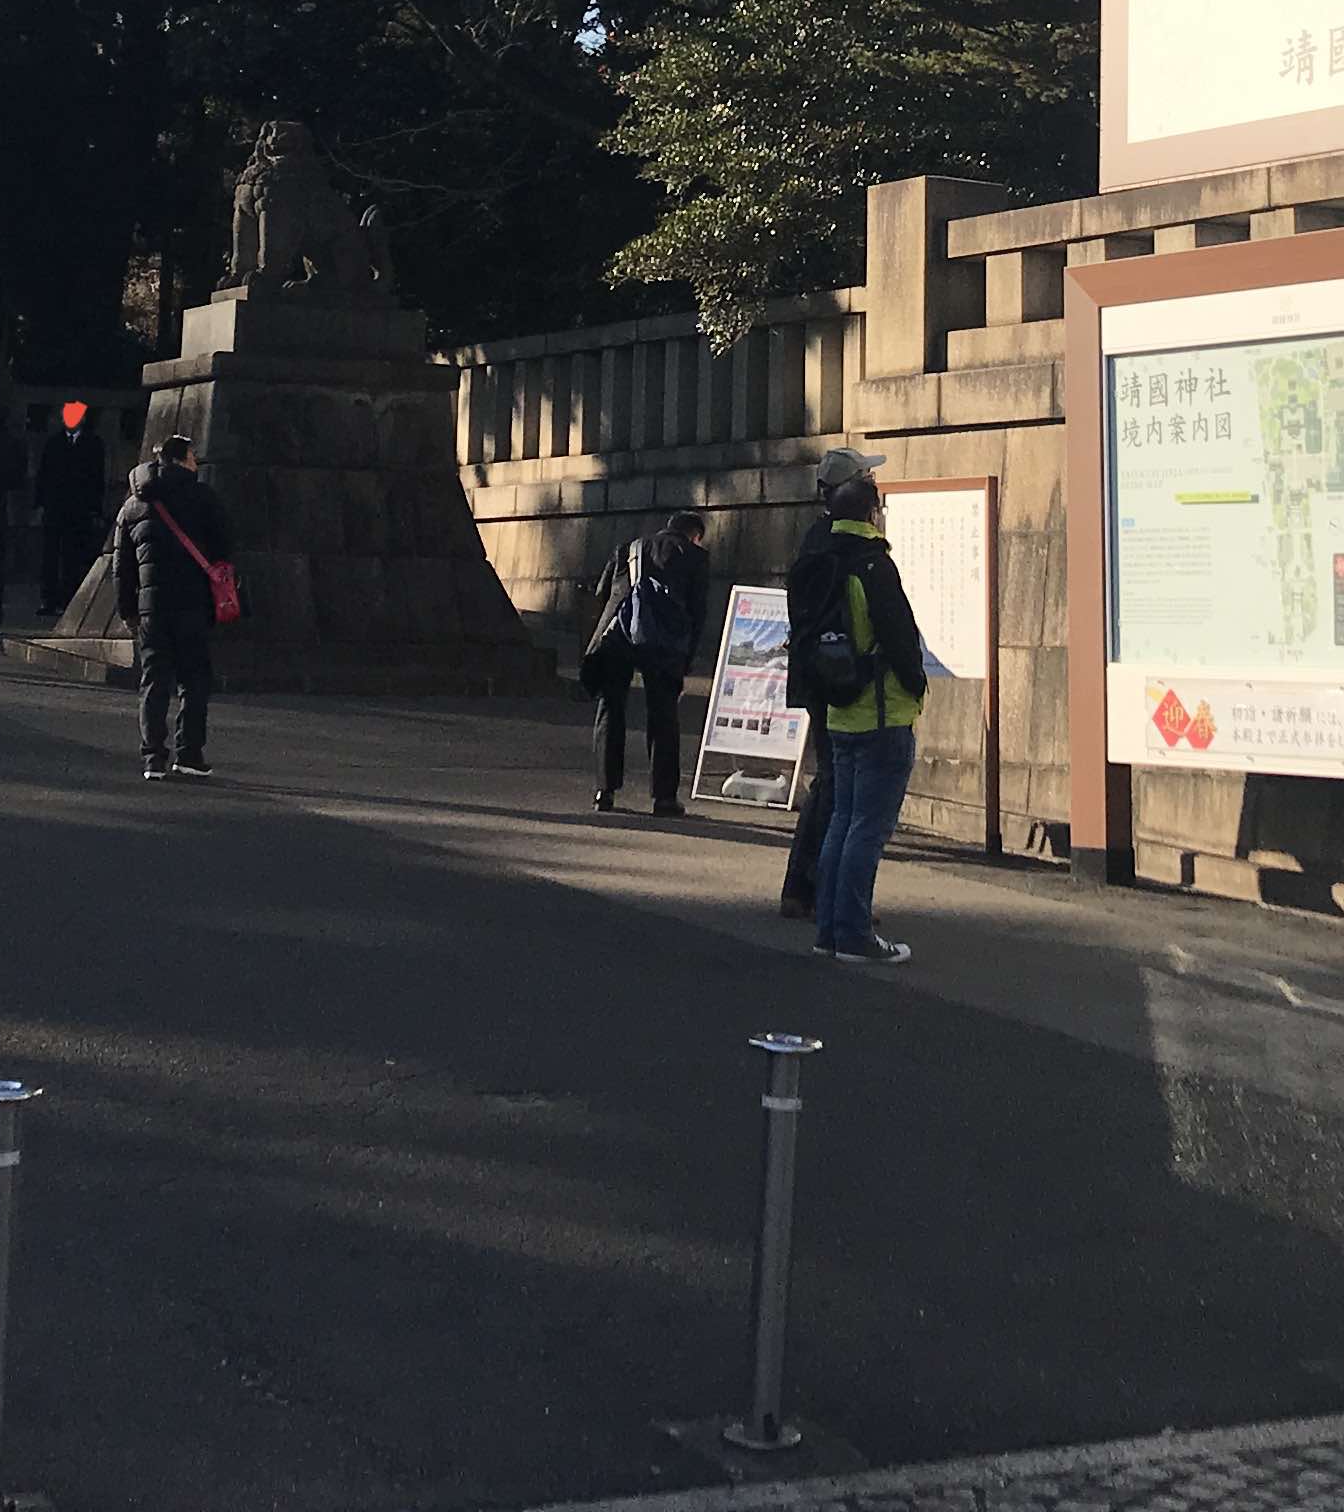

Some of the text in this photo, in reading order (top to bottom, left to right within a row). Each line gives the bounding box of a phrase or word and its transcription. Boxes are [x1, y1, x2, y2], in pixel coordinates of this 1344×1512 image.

[1119, 367, 1232, 409] 靖國神社
[1120, 411, 1233, 449] 境内案内図
[1161, 698, 1218, 740] 迎春
